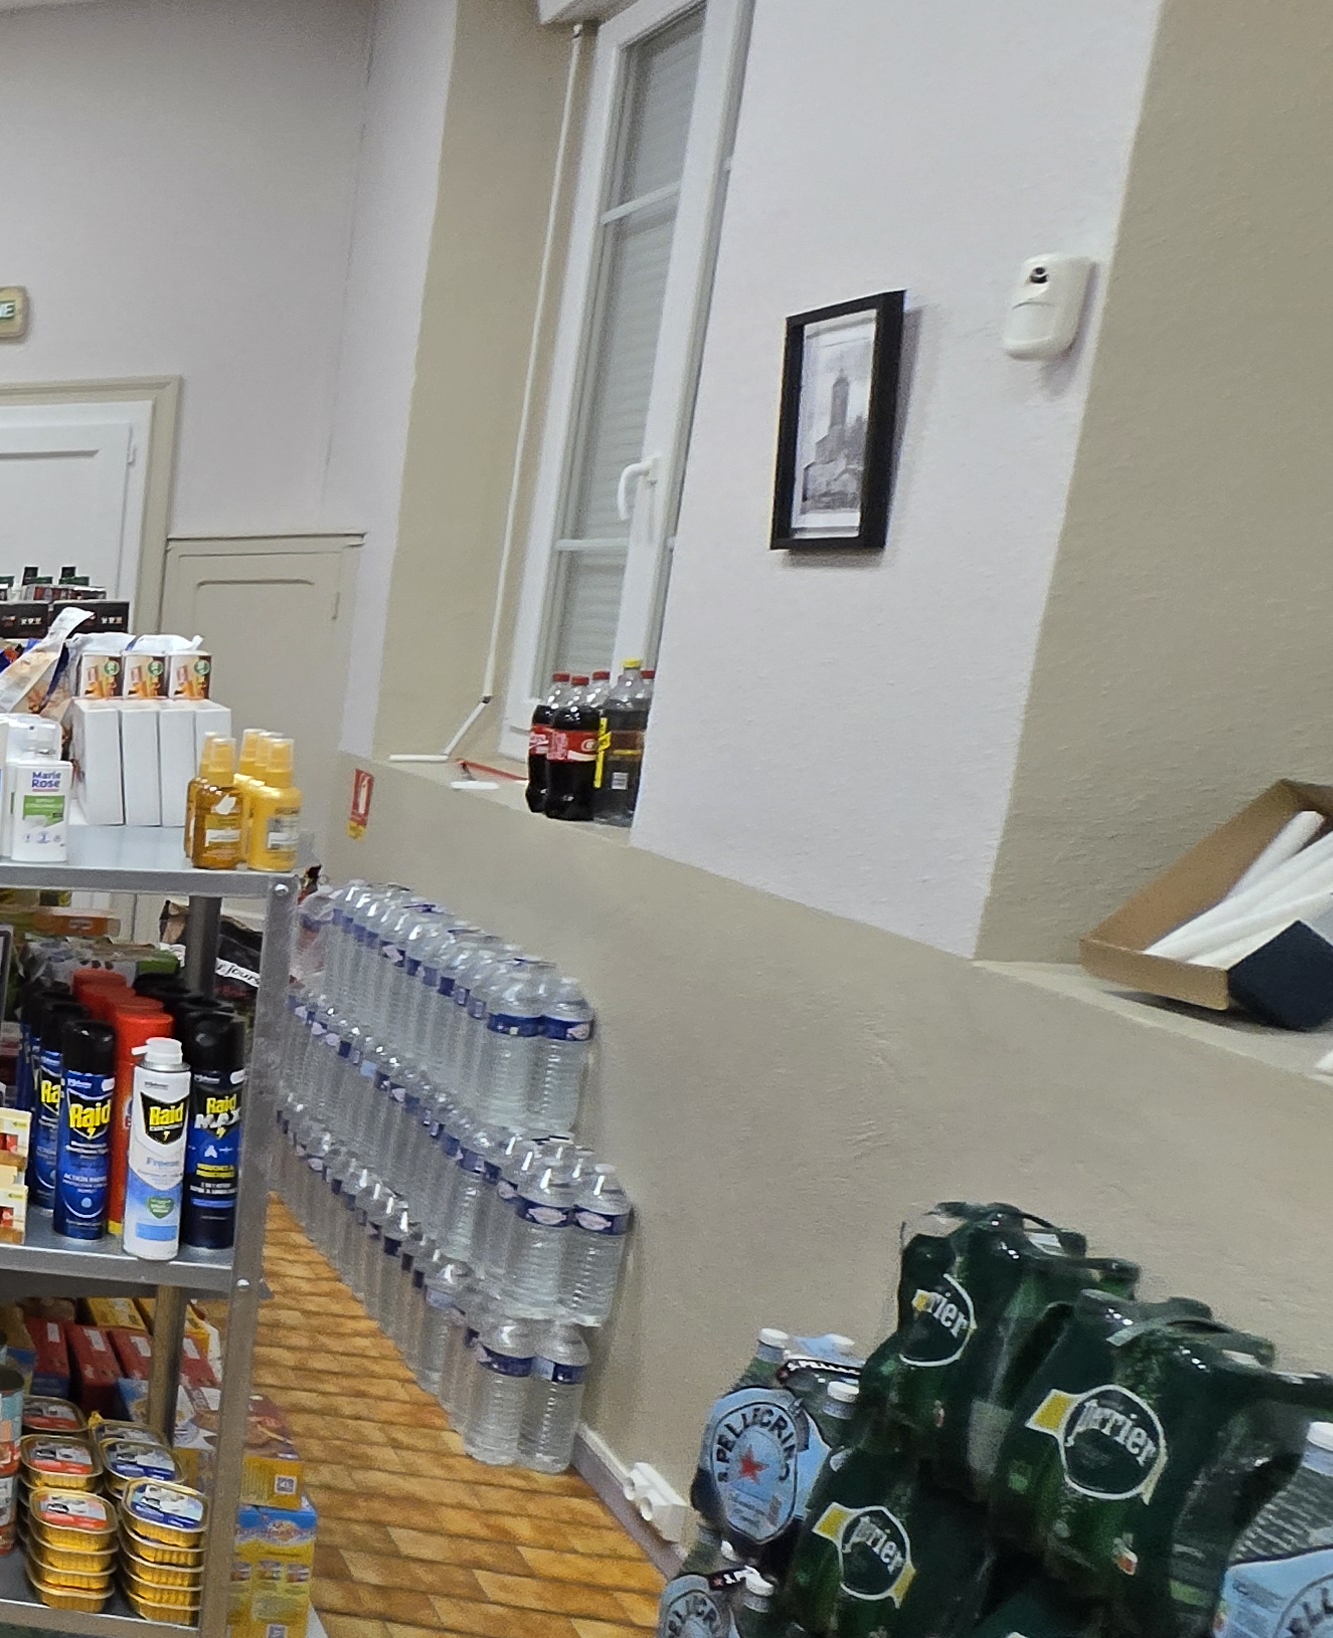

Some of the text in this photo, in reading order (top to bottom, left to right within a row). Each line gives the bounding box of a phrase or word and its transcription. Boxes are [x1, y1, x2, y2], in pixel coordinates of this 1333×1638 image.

[31, 779, 60, 788] Rose
[32, 771, 61, 780] Marie
[41, 1080, 62, 1104] Ra
[69, 1100, 112, 1128] Raid
[149, 1103, 184, 1126] Raid
[206, 1094, 237, 1115] Raid
[194, 1107, 242, 1129] MAX
